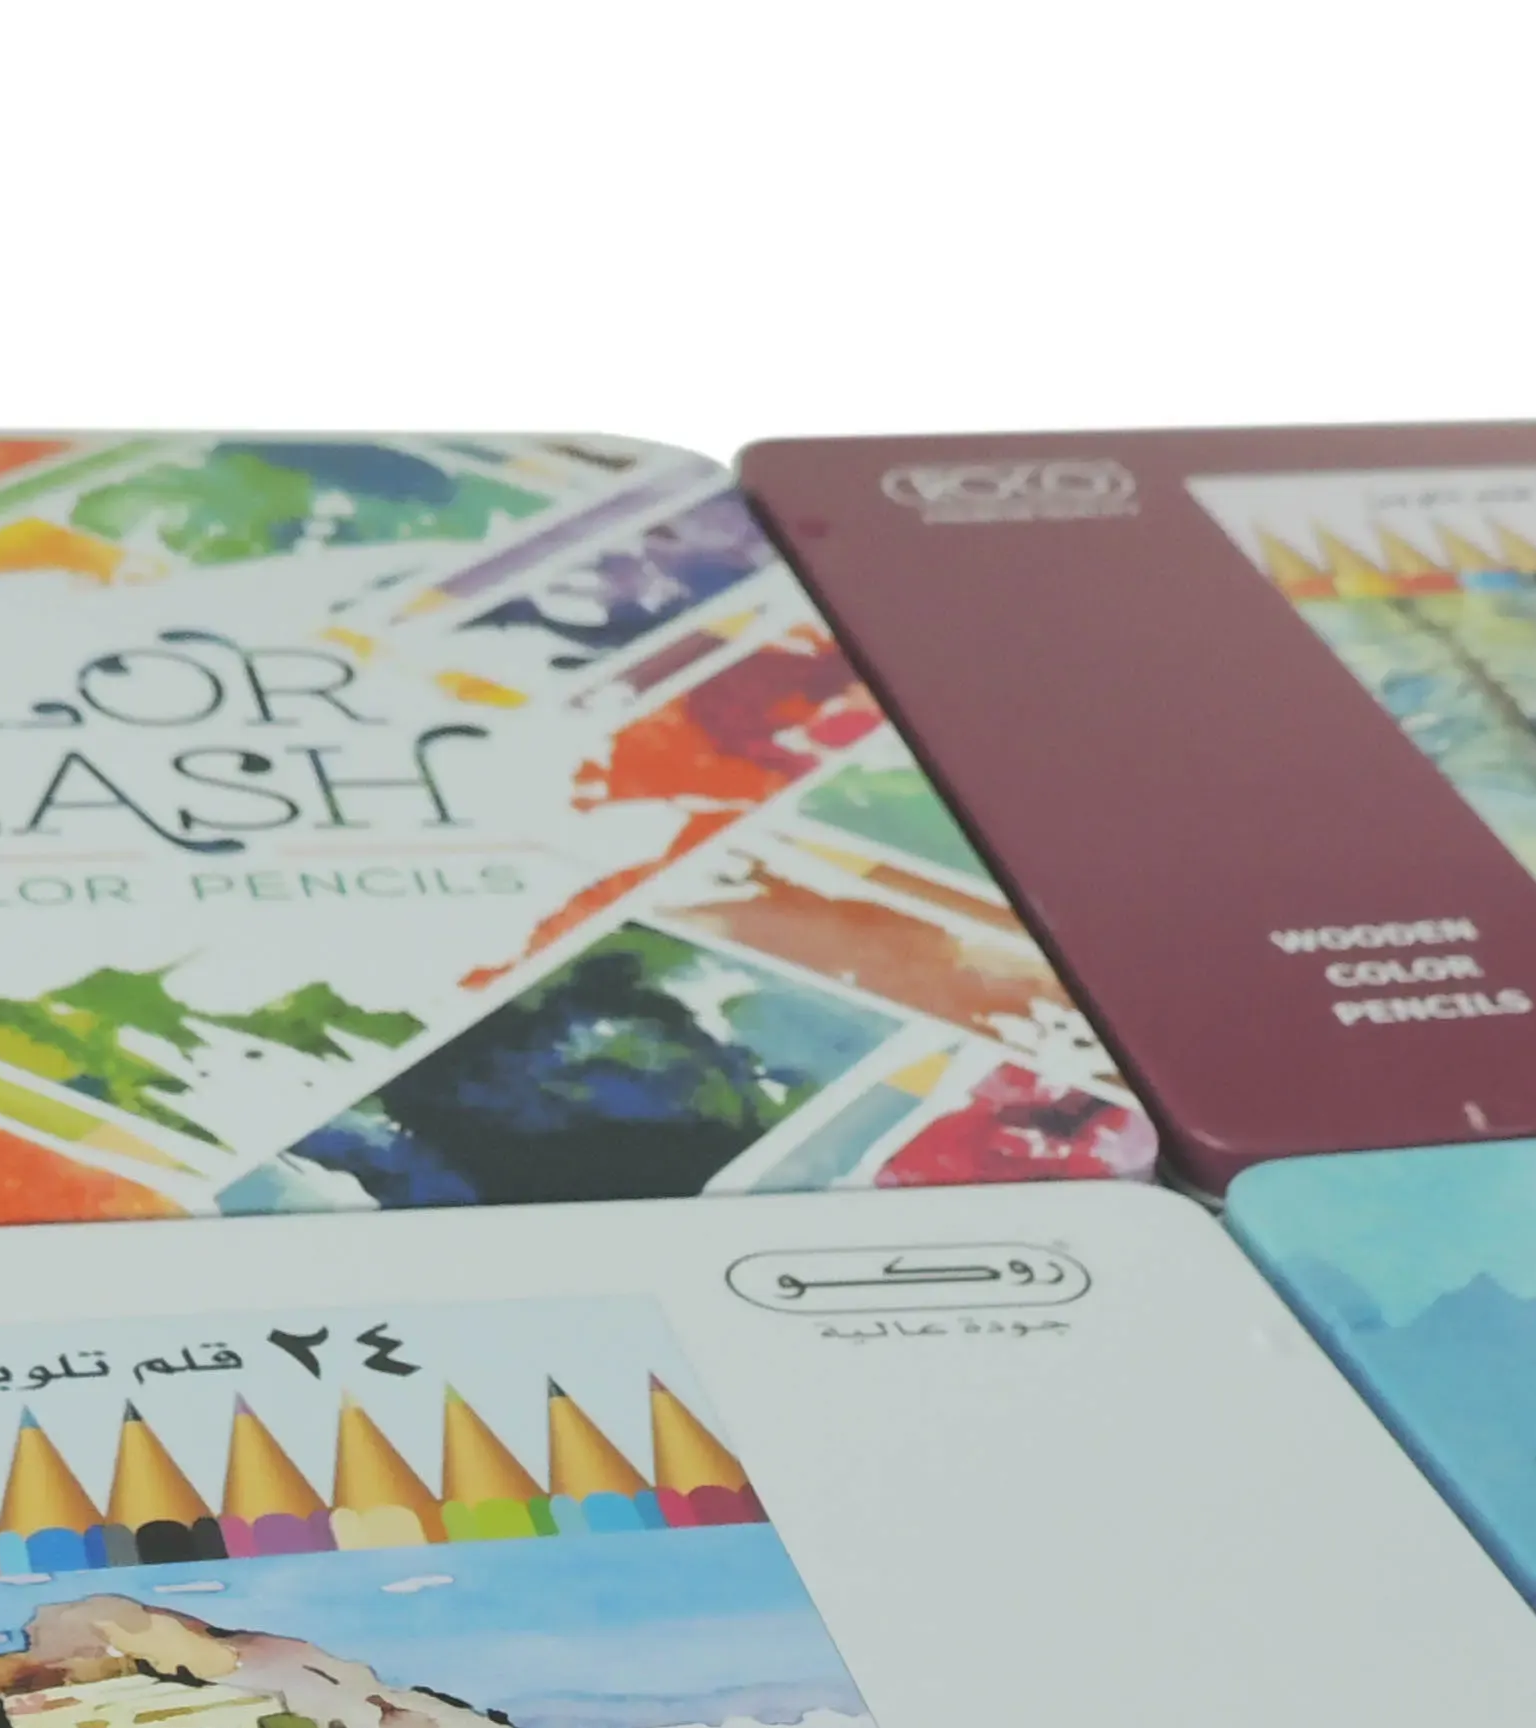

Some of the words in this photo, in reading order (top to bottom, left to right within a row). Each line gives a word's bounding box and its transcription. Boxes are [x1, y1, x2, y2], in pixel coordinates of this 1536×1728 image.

[190, 862, 527, 903] PENCILS
[1268, 916, 1480, 954] WOODEN
[1324, 954, 1485, 988] COLOR
[1331, 987, 1534, 1027] PENCILS
[132, 1341, 245, 1385] قلم
[266, 1322, 423, 1381] ٢٤
